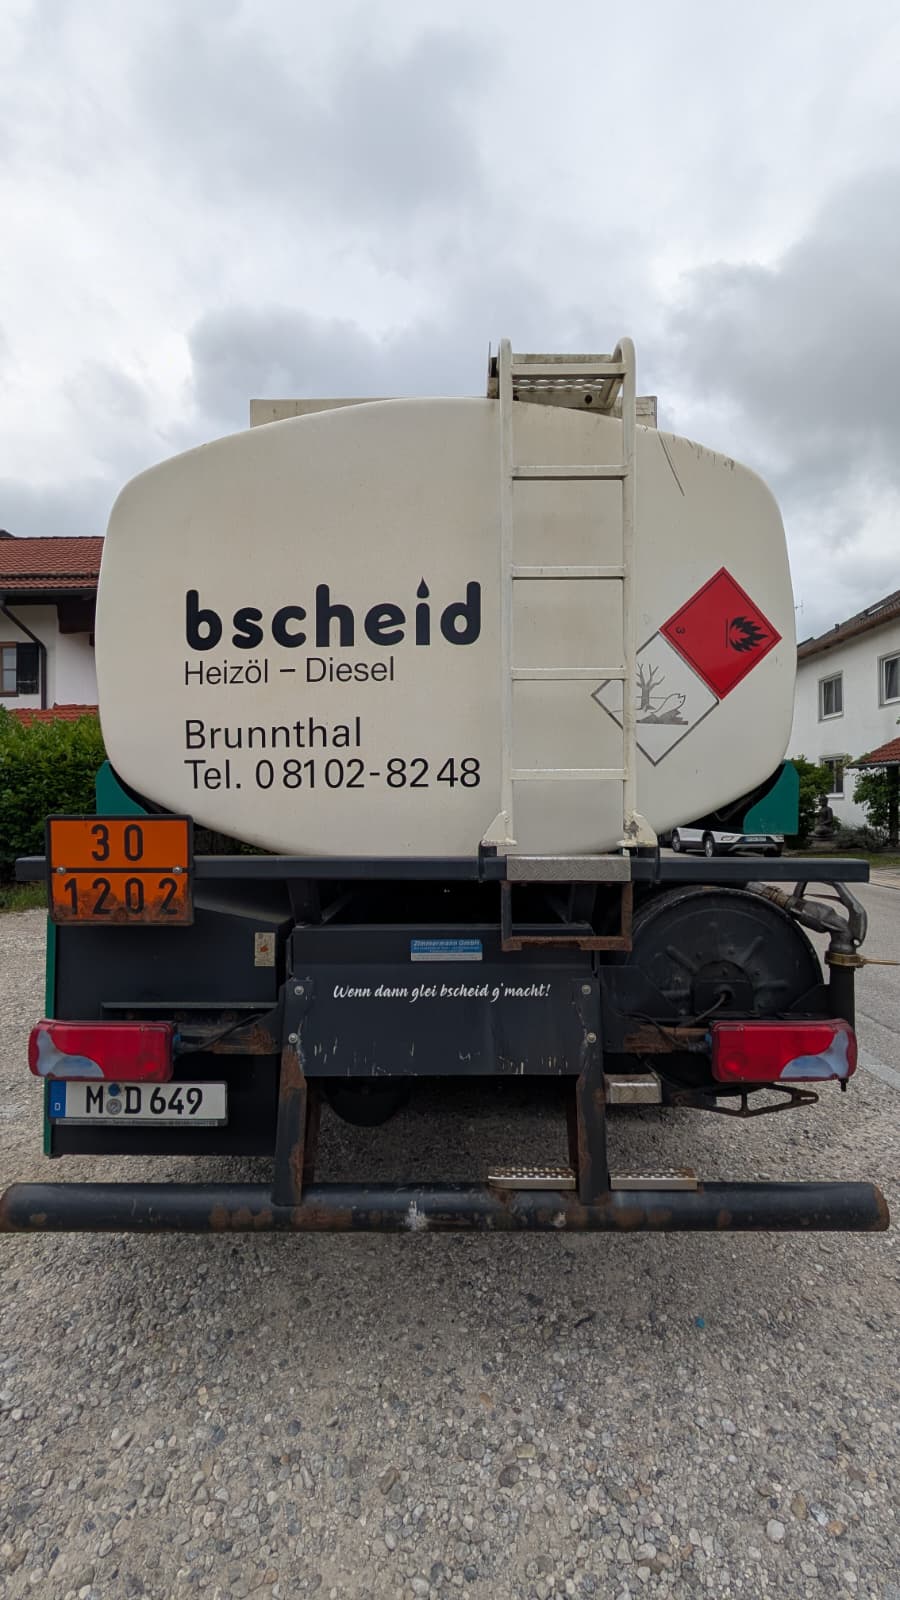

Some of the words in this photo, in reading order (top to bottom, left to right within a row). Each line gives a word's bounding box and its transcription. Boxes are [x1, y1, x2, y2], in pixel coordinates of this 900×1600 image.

[185, 577, 482, 652] bscheid
[184, 659, 269, 686] Heizöl
[306, 655, 394, 683] Diesel
[185, 716, 361, 750] Brunnthal
[184, 758, 242, 790] Tel.
[333, 984, 371, 998] Wenn
[374, 984, 408, 998] dann
[409, 983, 438, 1003] glei
[439, 983, 489, 998] bscheid
[85, 1084, 104, 1114] M
[149, 1086, 203, 1115] 649
